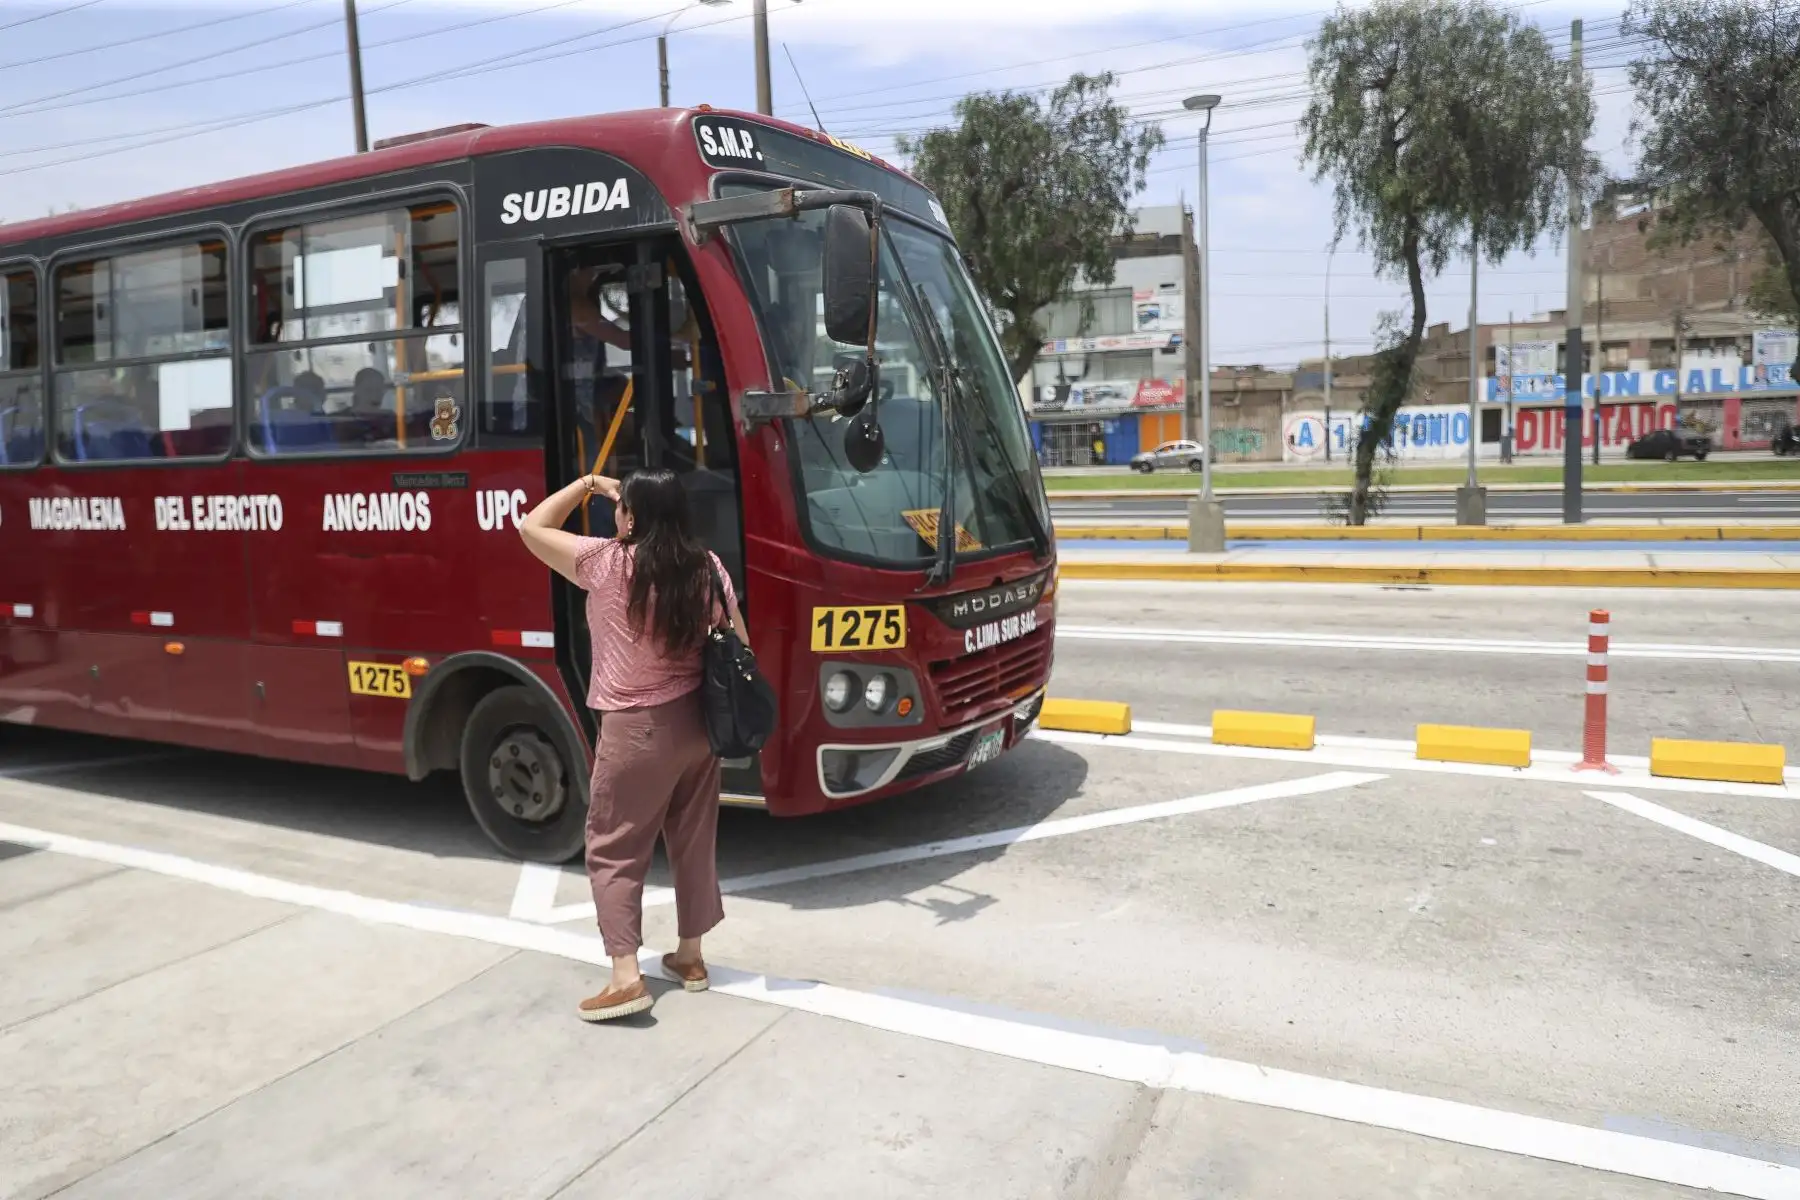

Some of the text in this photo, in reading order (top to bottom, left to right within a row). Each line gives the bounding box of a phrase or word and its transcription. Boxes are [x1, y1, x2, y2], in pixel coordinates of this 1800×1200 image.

[700, 124, 763, 161] S.M.P.
[500, 178, 630, 225] SUBIDA
[28, 497, 126, 531] MAGDALENA
[154, 496, 190, 530] DEL
[191, 494, 283, 531] EJERCITO
[322, 491, 432, 532] ANGAMOS
[476, 488, 528, 532] UPC
[953, 584, 1038, 617] MODASA
[817, 608, 902, 647] 1275
[977, 619, 1000, 650] LIMA
[1001, 614, 1019, 642] SUR
[354, 666, 405, 693] 1275
